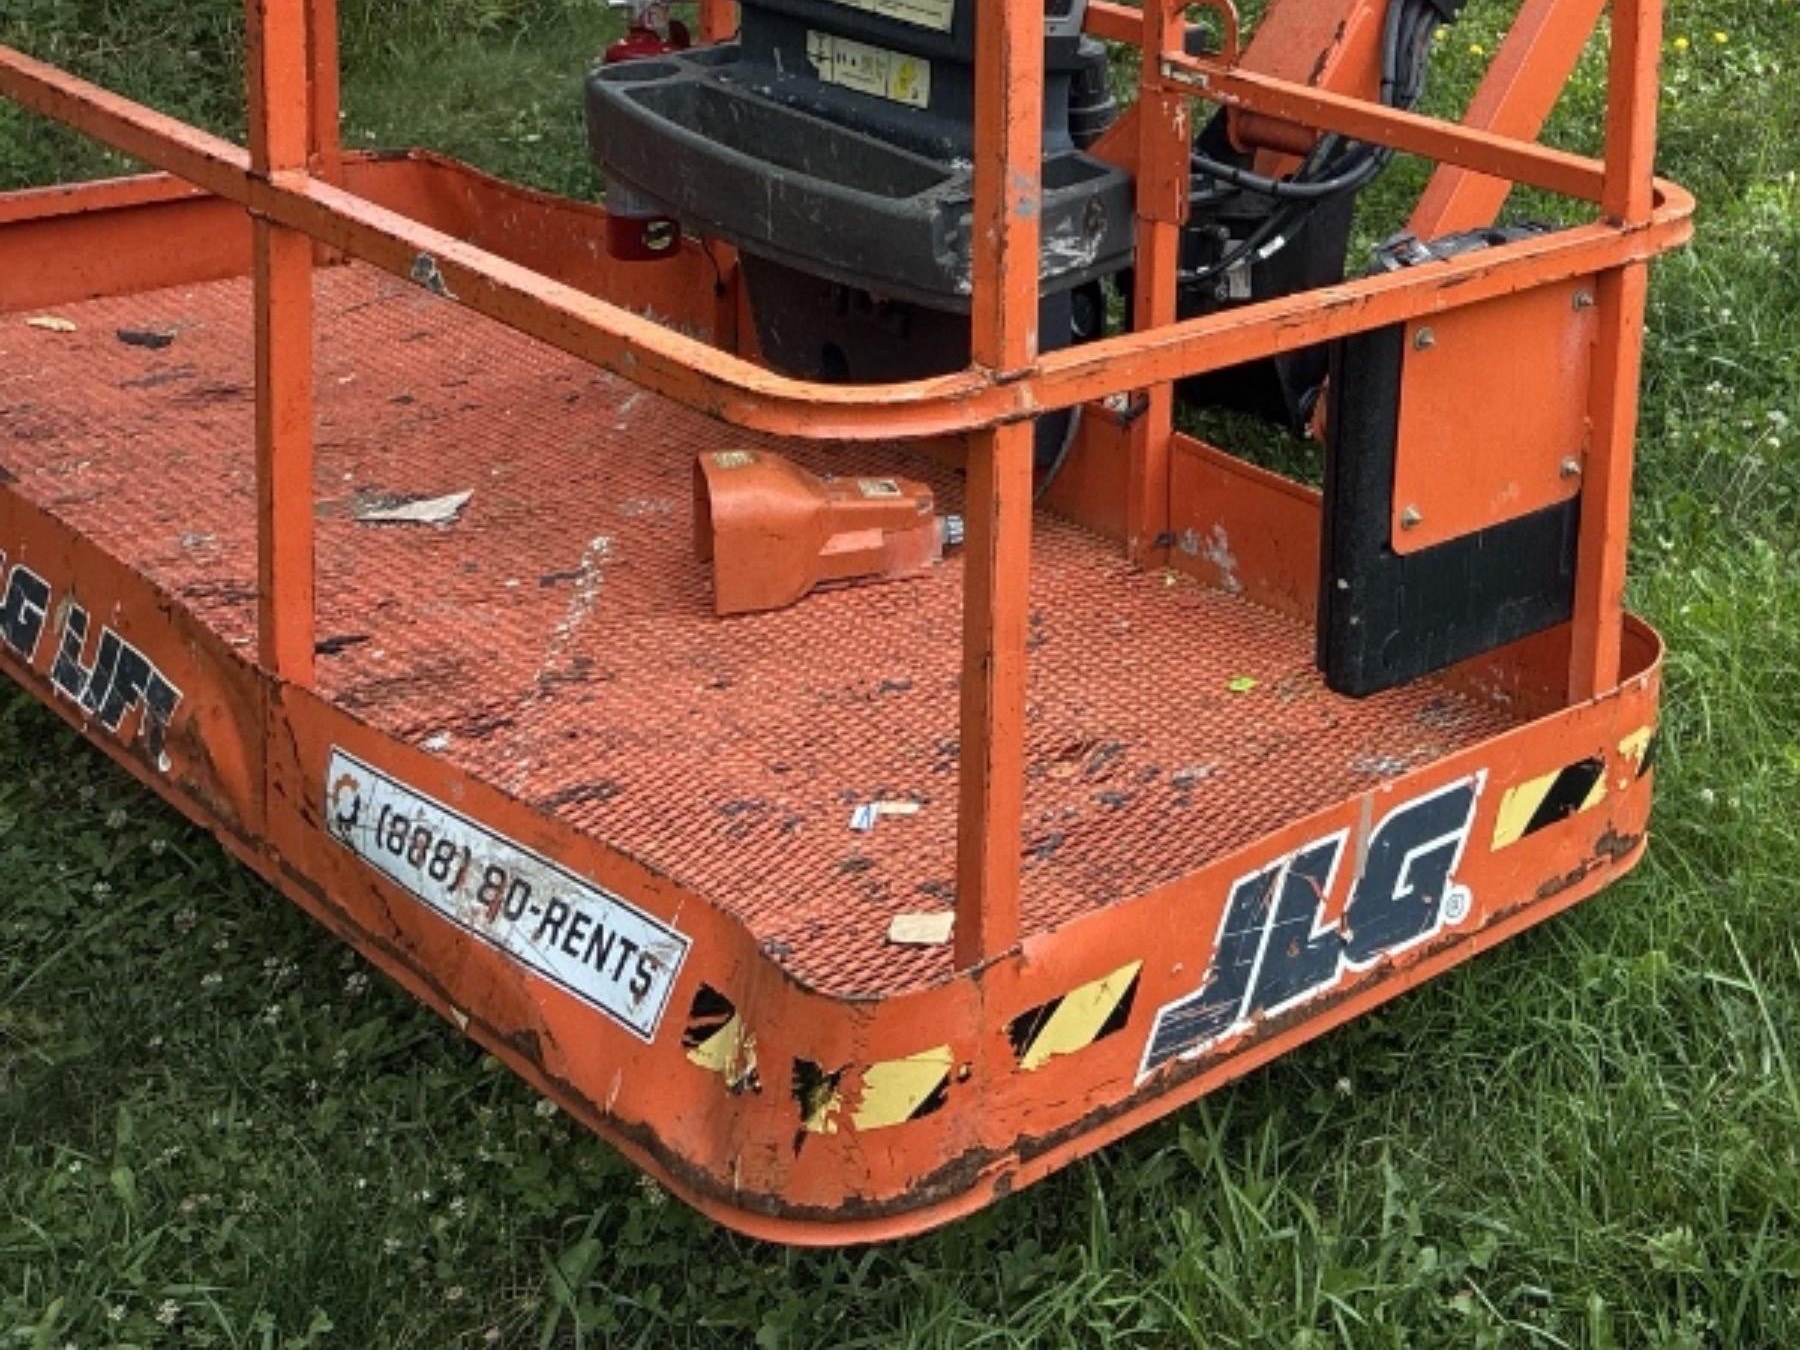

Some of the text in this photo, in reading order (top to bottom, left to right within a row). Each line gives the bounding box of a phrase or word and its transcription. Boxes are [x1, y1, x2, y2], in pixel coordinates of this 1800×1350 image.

[376, 803, 660, 1005] (888) 80-RENTS
[1133, 768, 1489, 1088] JLG
